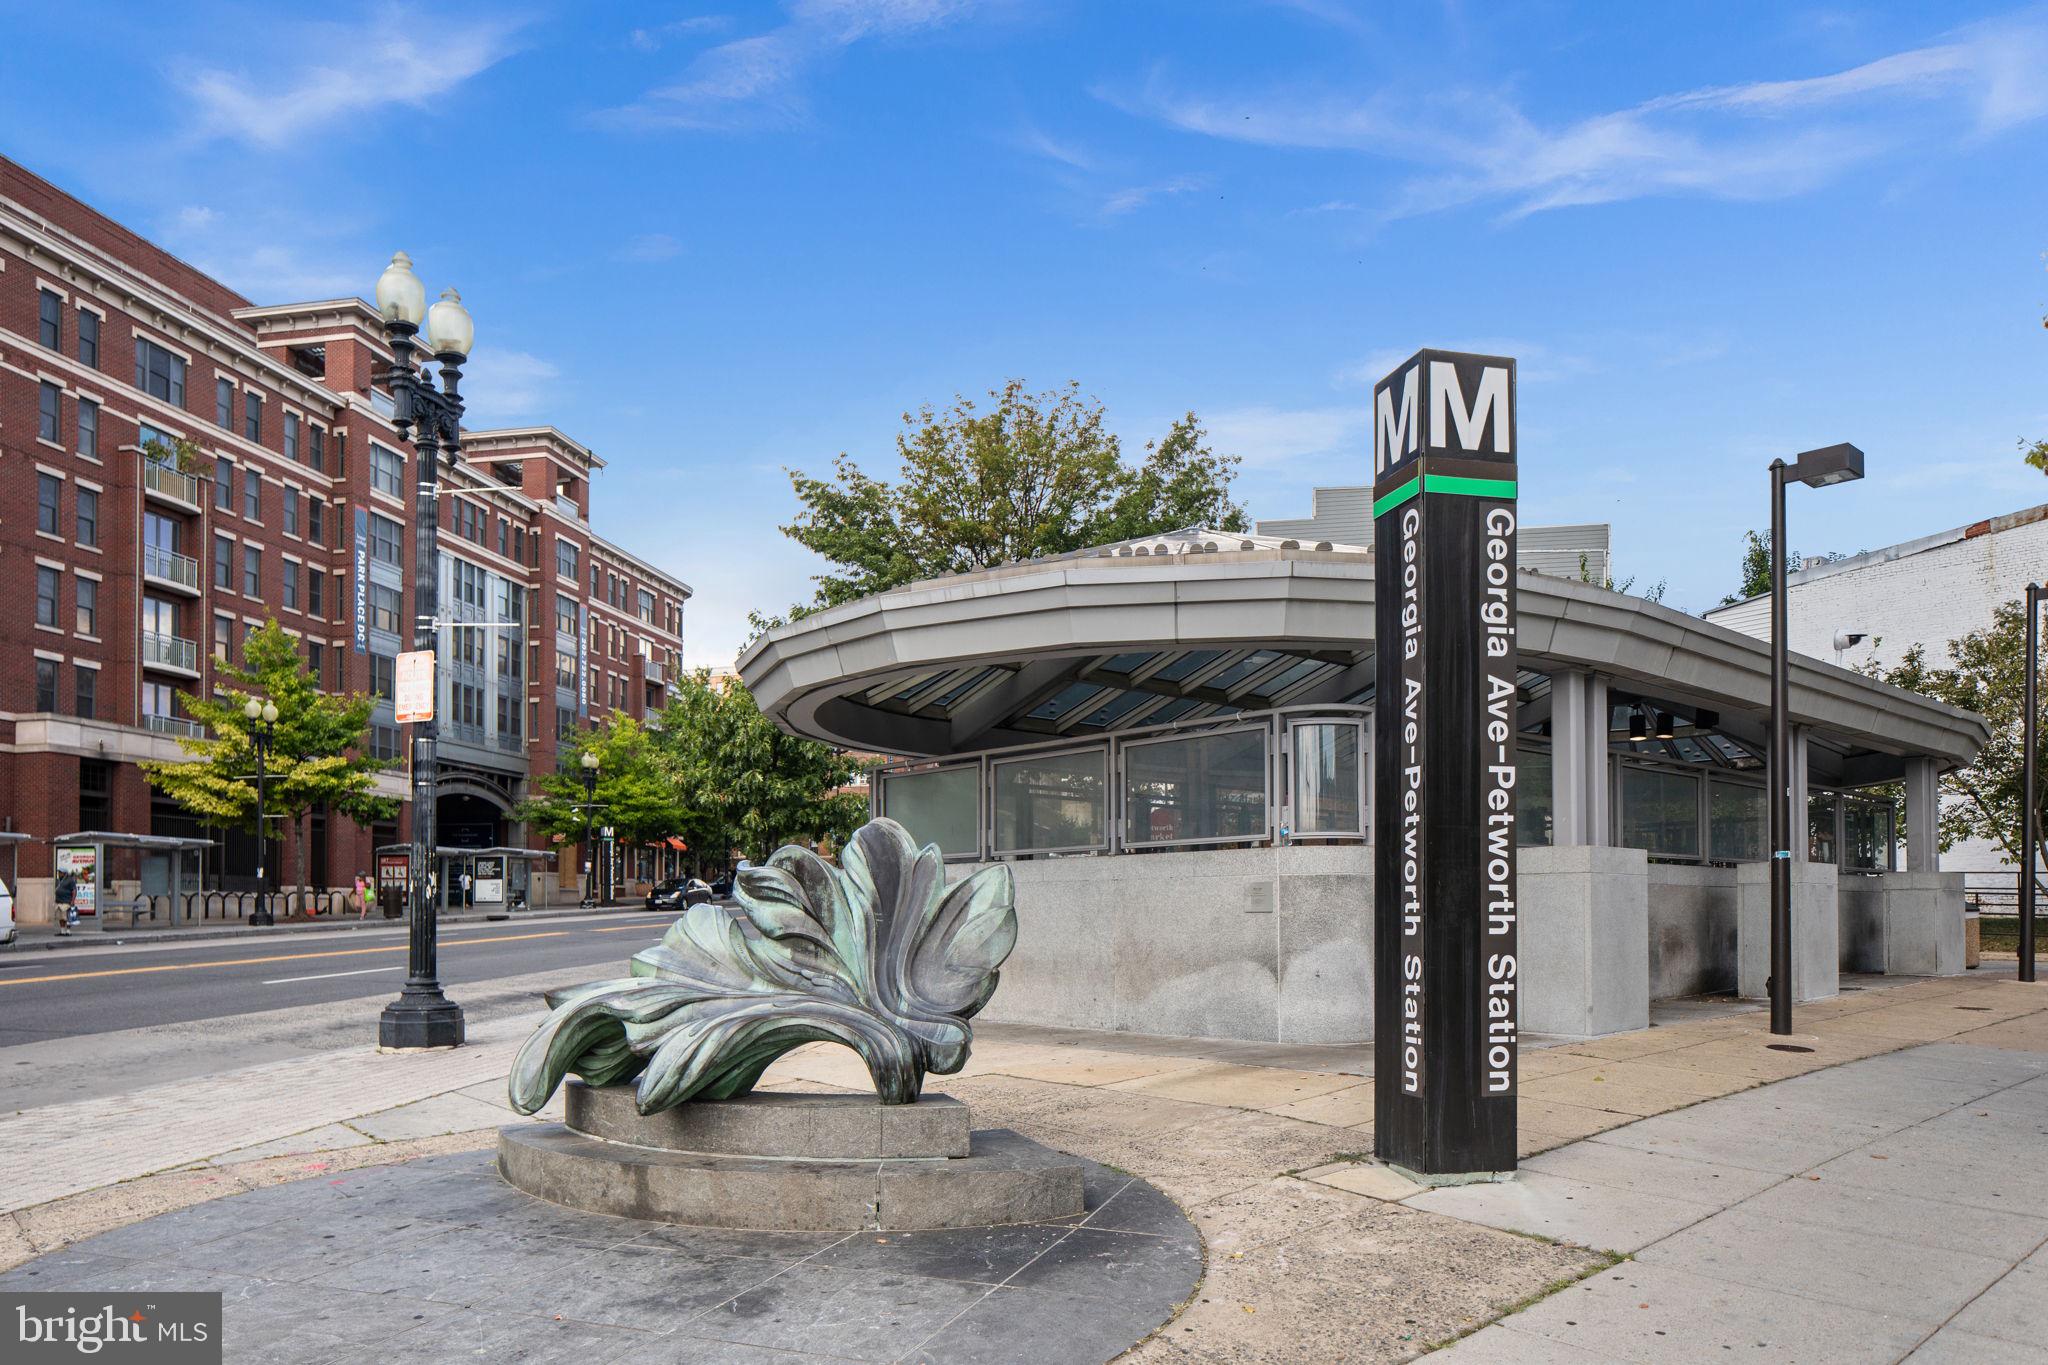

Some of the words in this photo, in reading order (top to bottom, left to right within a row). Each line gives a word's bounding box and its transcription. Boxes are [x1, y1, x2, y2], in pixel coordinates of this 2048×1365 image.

[1377, 364, 1420, 476] M
[1430, 361, 1510, 453] M
[357, 550, 366, 582] PARK
[357, 584, 366, 623] PLACE
[1401, 508, 1422, 661] Georgia
[1480, 508, 1515, 657] Georgia
[357, 624, 365, 643] DC
[604, 826, 614, 837] M
[1404, 954, 1422, 1092] Station
[1487, 953, 1517, 1092] Station
